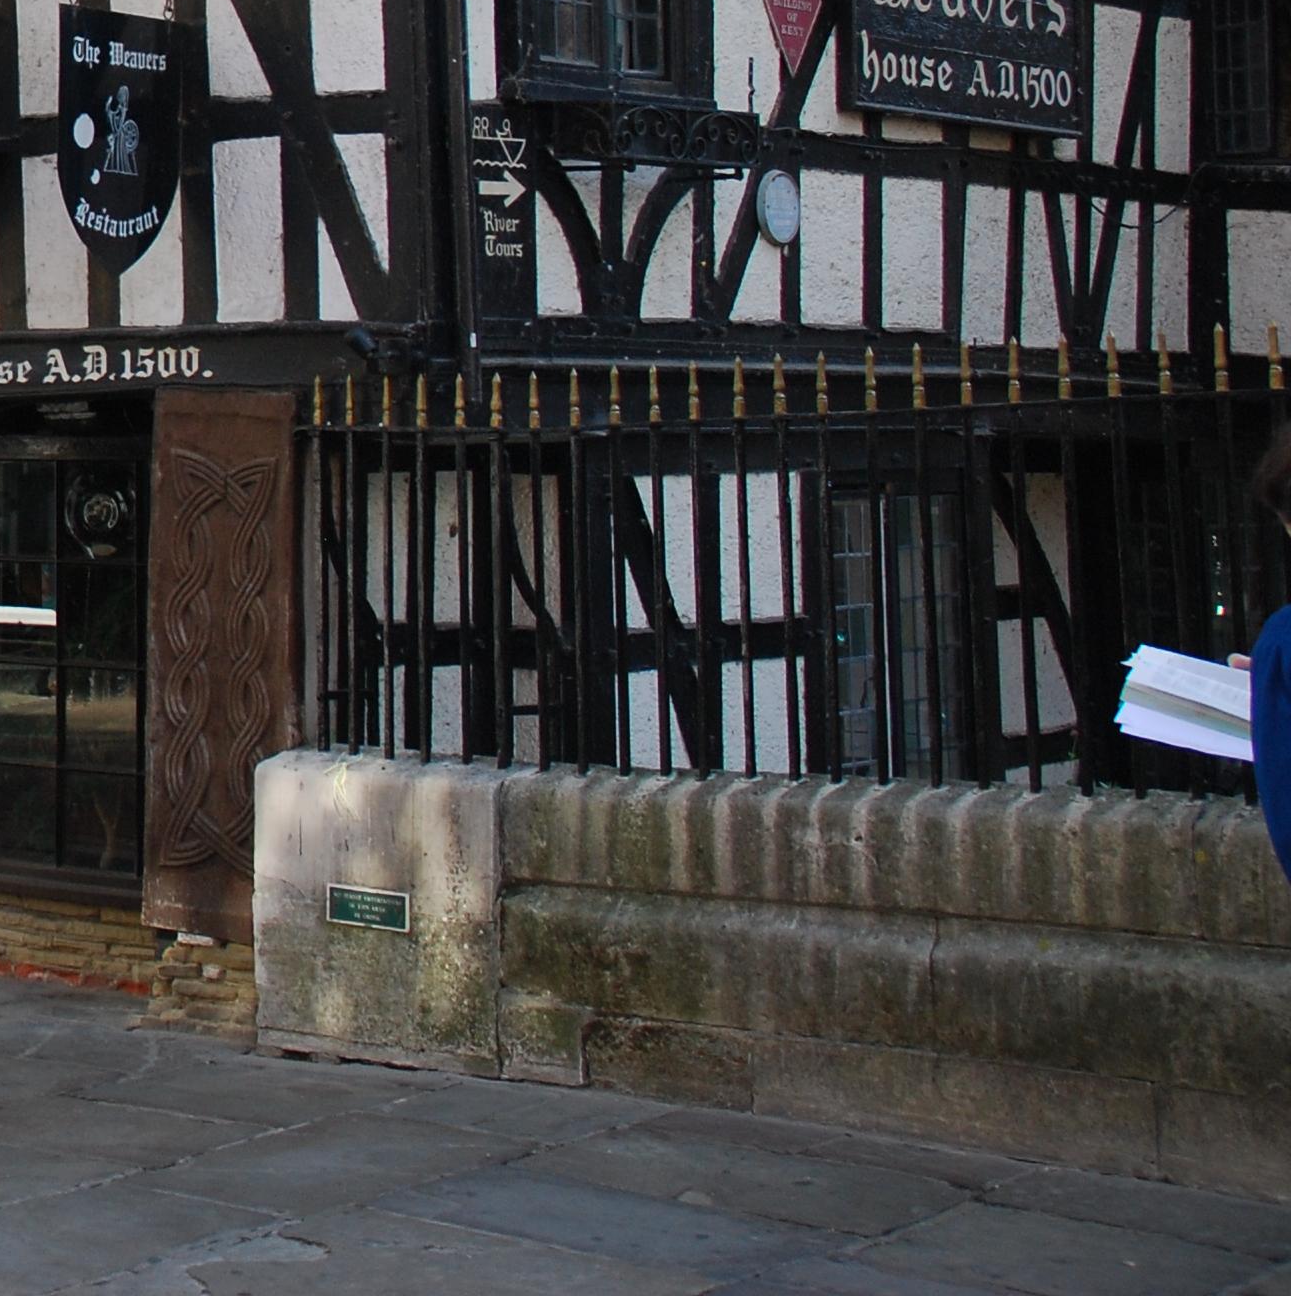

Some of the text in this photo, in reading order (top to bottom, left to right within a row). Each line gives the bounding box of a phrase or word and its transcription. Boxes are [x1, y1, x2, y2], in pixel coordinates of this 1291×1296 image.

[786, 12, 798, 23] OF
[781, 25, 804, 37] KENT
[72, 35, 167, 71] The Weavers
[861, 29, 954, 93] house
[75, 197, 159, 238] Restaurant
[481, 209, 520, 232] River
[484, 235, 523, 257] Tours
